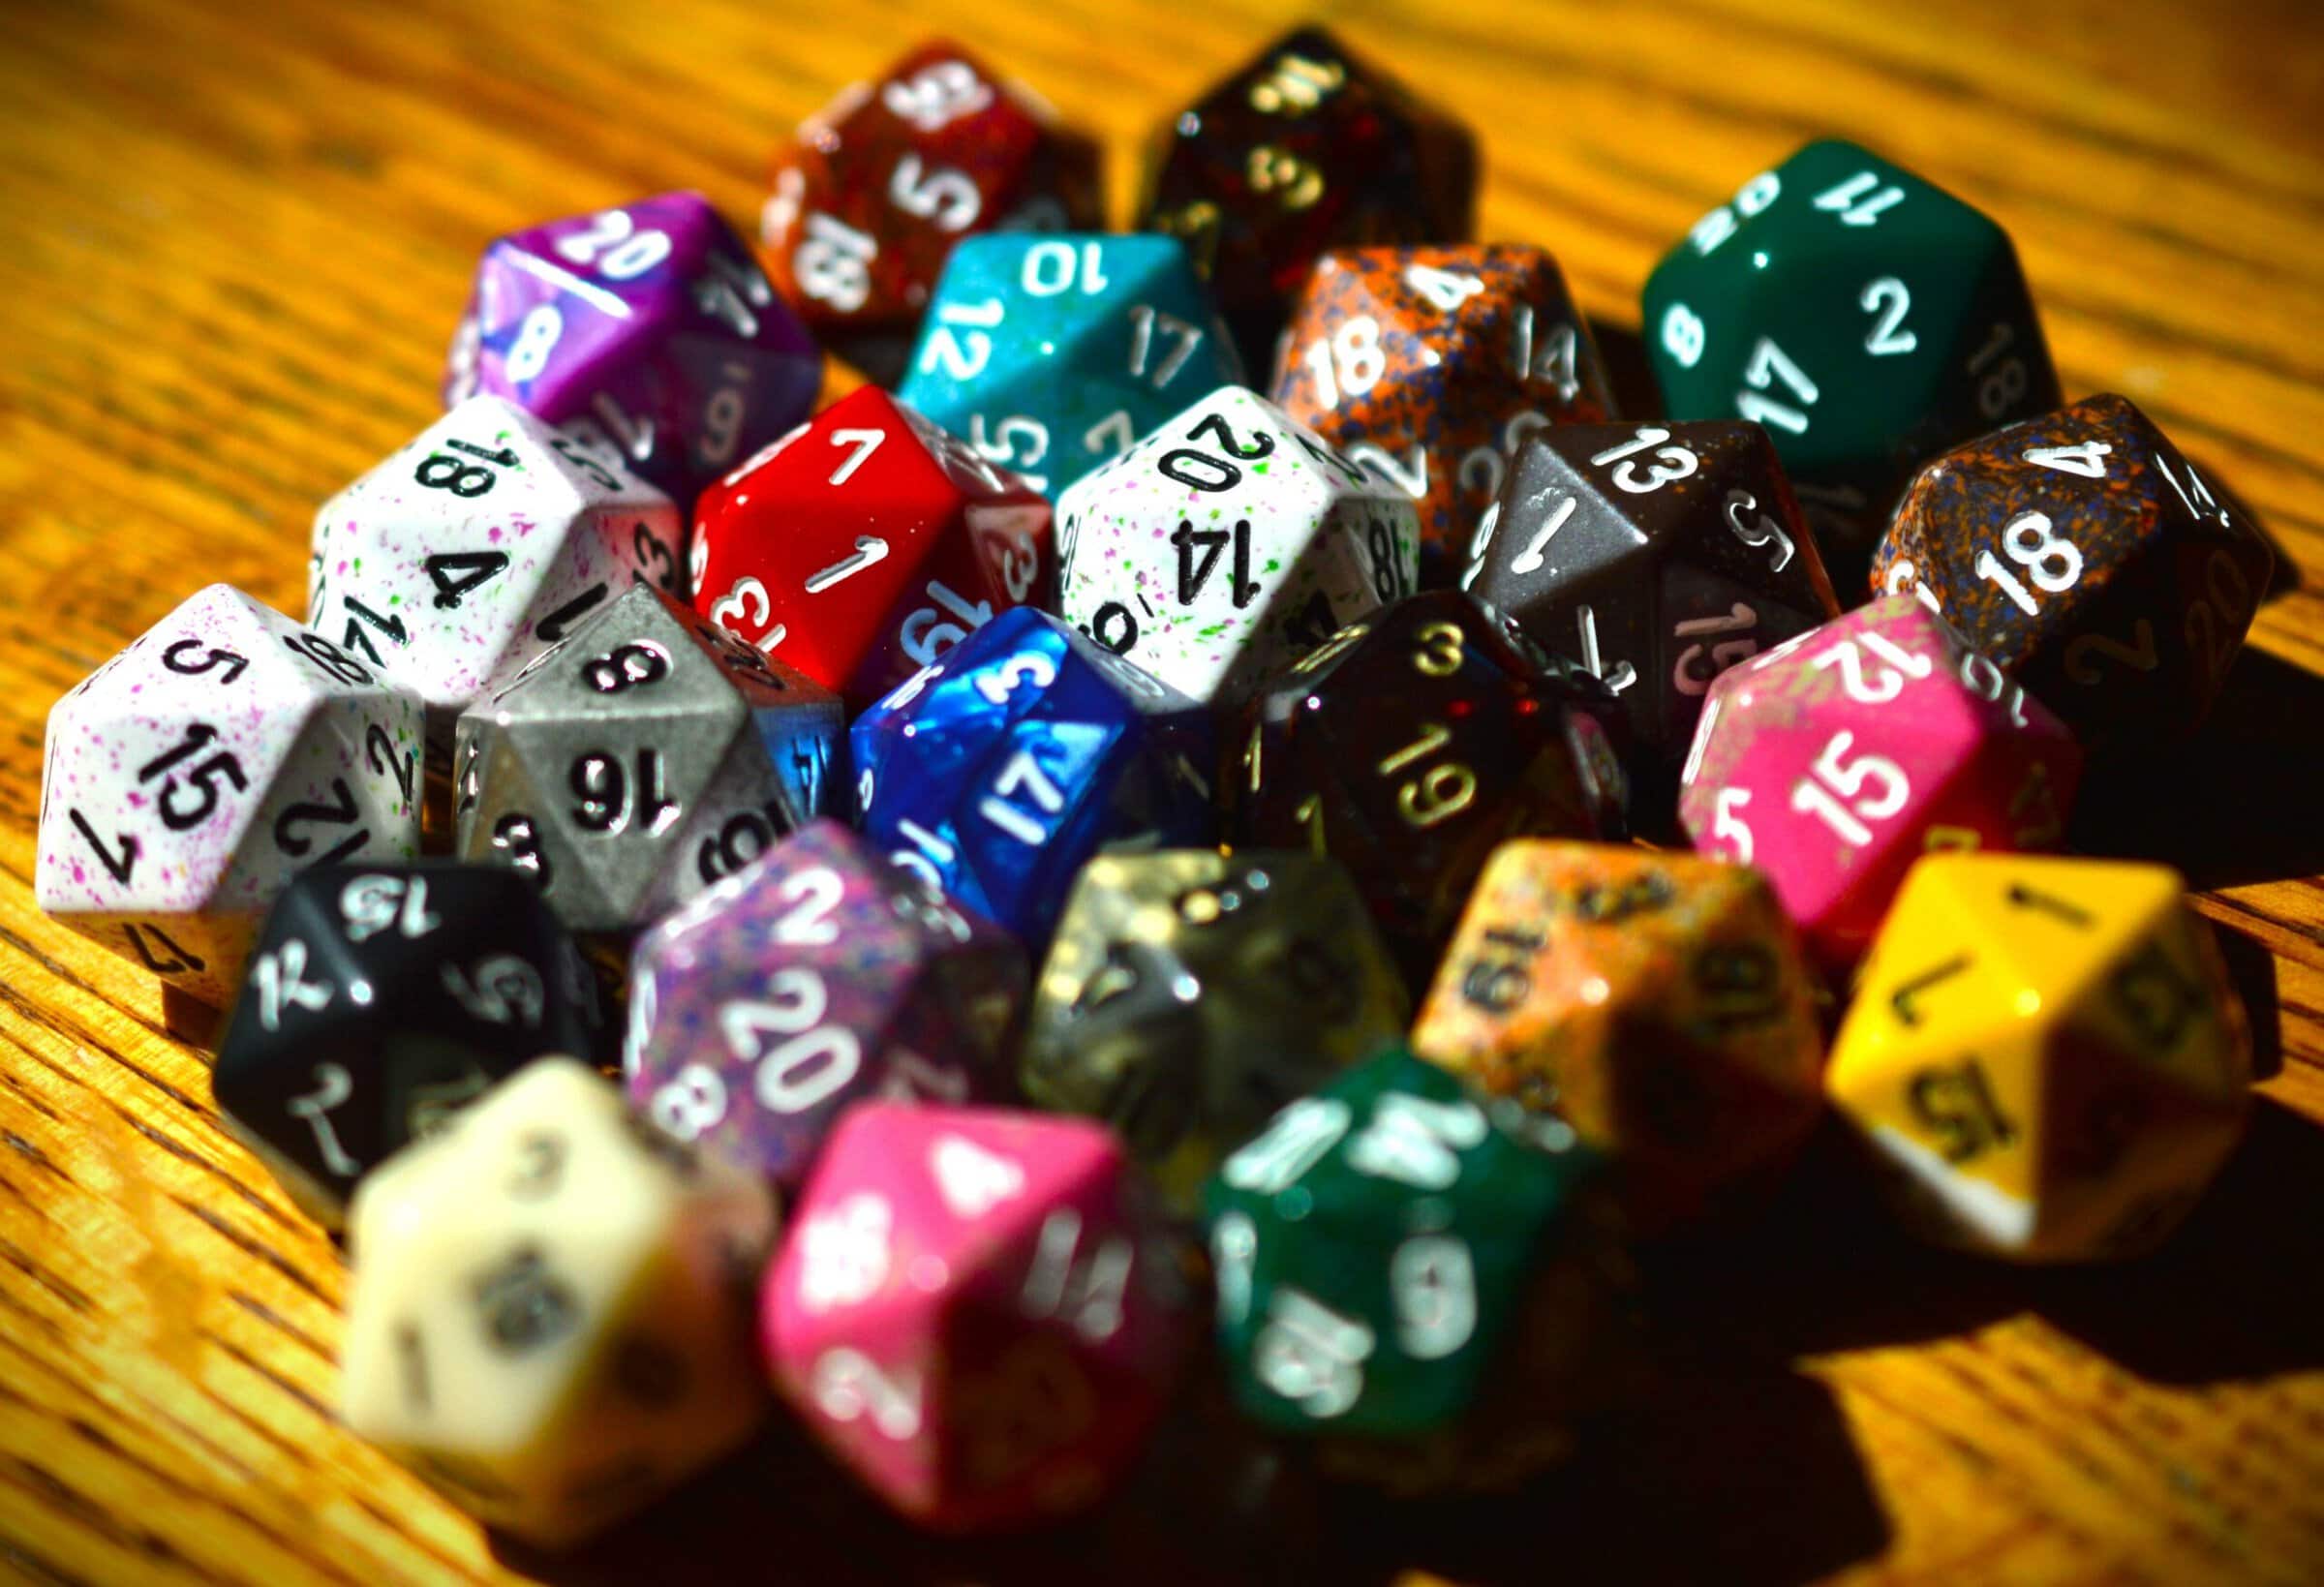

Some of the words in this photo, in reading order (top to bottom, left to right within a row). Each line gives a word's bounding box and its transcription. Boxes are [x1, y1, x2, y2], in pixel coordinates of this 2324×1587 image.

[891, 154, 980, 232] 5
[556, 210, 672, 279] 20
[1020, 241, 1109, 296] 10
[1405, 266, 1484, 310] 4
[1860, 277, 1917, 355] 2
[506, 304, 563, 382] 8
[919, 298, 1005, 380] 12
[1128, 303, 1204, 388] 17
[1305, 317, 1386, 411] 18
[1514, 306, 1579, 400] 14
[1661, 303, 1705, 367] 8
[1736, 336, 1819, 434] 17
[414, 439, 520, 498] 18
[829, 428, 885, 486] 7
[1158, 413, 1275, 492] 20
[1590, 427, 1698, 493] 13
[2022, 441, 2112, 478] 4
[805, 535, 889, 594] 1
[1171, 520, 1261, 609] 14
[1511, 497, 1576, 573] 1
[1723, 489, 1795, 573] 5
[1974, 510, 2084, 617] 18
[424, 551, 510, 609] 4
[163, 639, 250, 685] 5
[283, 633, 374, 687] 18
[581, 638, 674, 694] 8
[975, 651, 1055, 704] 3
[1415, 624, 1464, 675] 3
[1810, 630, 1932, 703] 12
[138, 723, 252, 833] 15
[366, 723, 416, 804] 2
[569, 747, 683, 839] 16
[979, 752, 1063, 845] 17
[1378, 723, 1477, 827] 19
[1790, 729, 1911, 845] 15
[70, 808, 138, 887] 7
[778, 866, 843, 945] 2
[2007, 882, 2095, 929] 1
[719, 967, 861, 1114] 20
[286, 1063, 361, 1176] 2
[651, 1064, 727, 1143] 8
